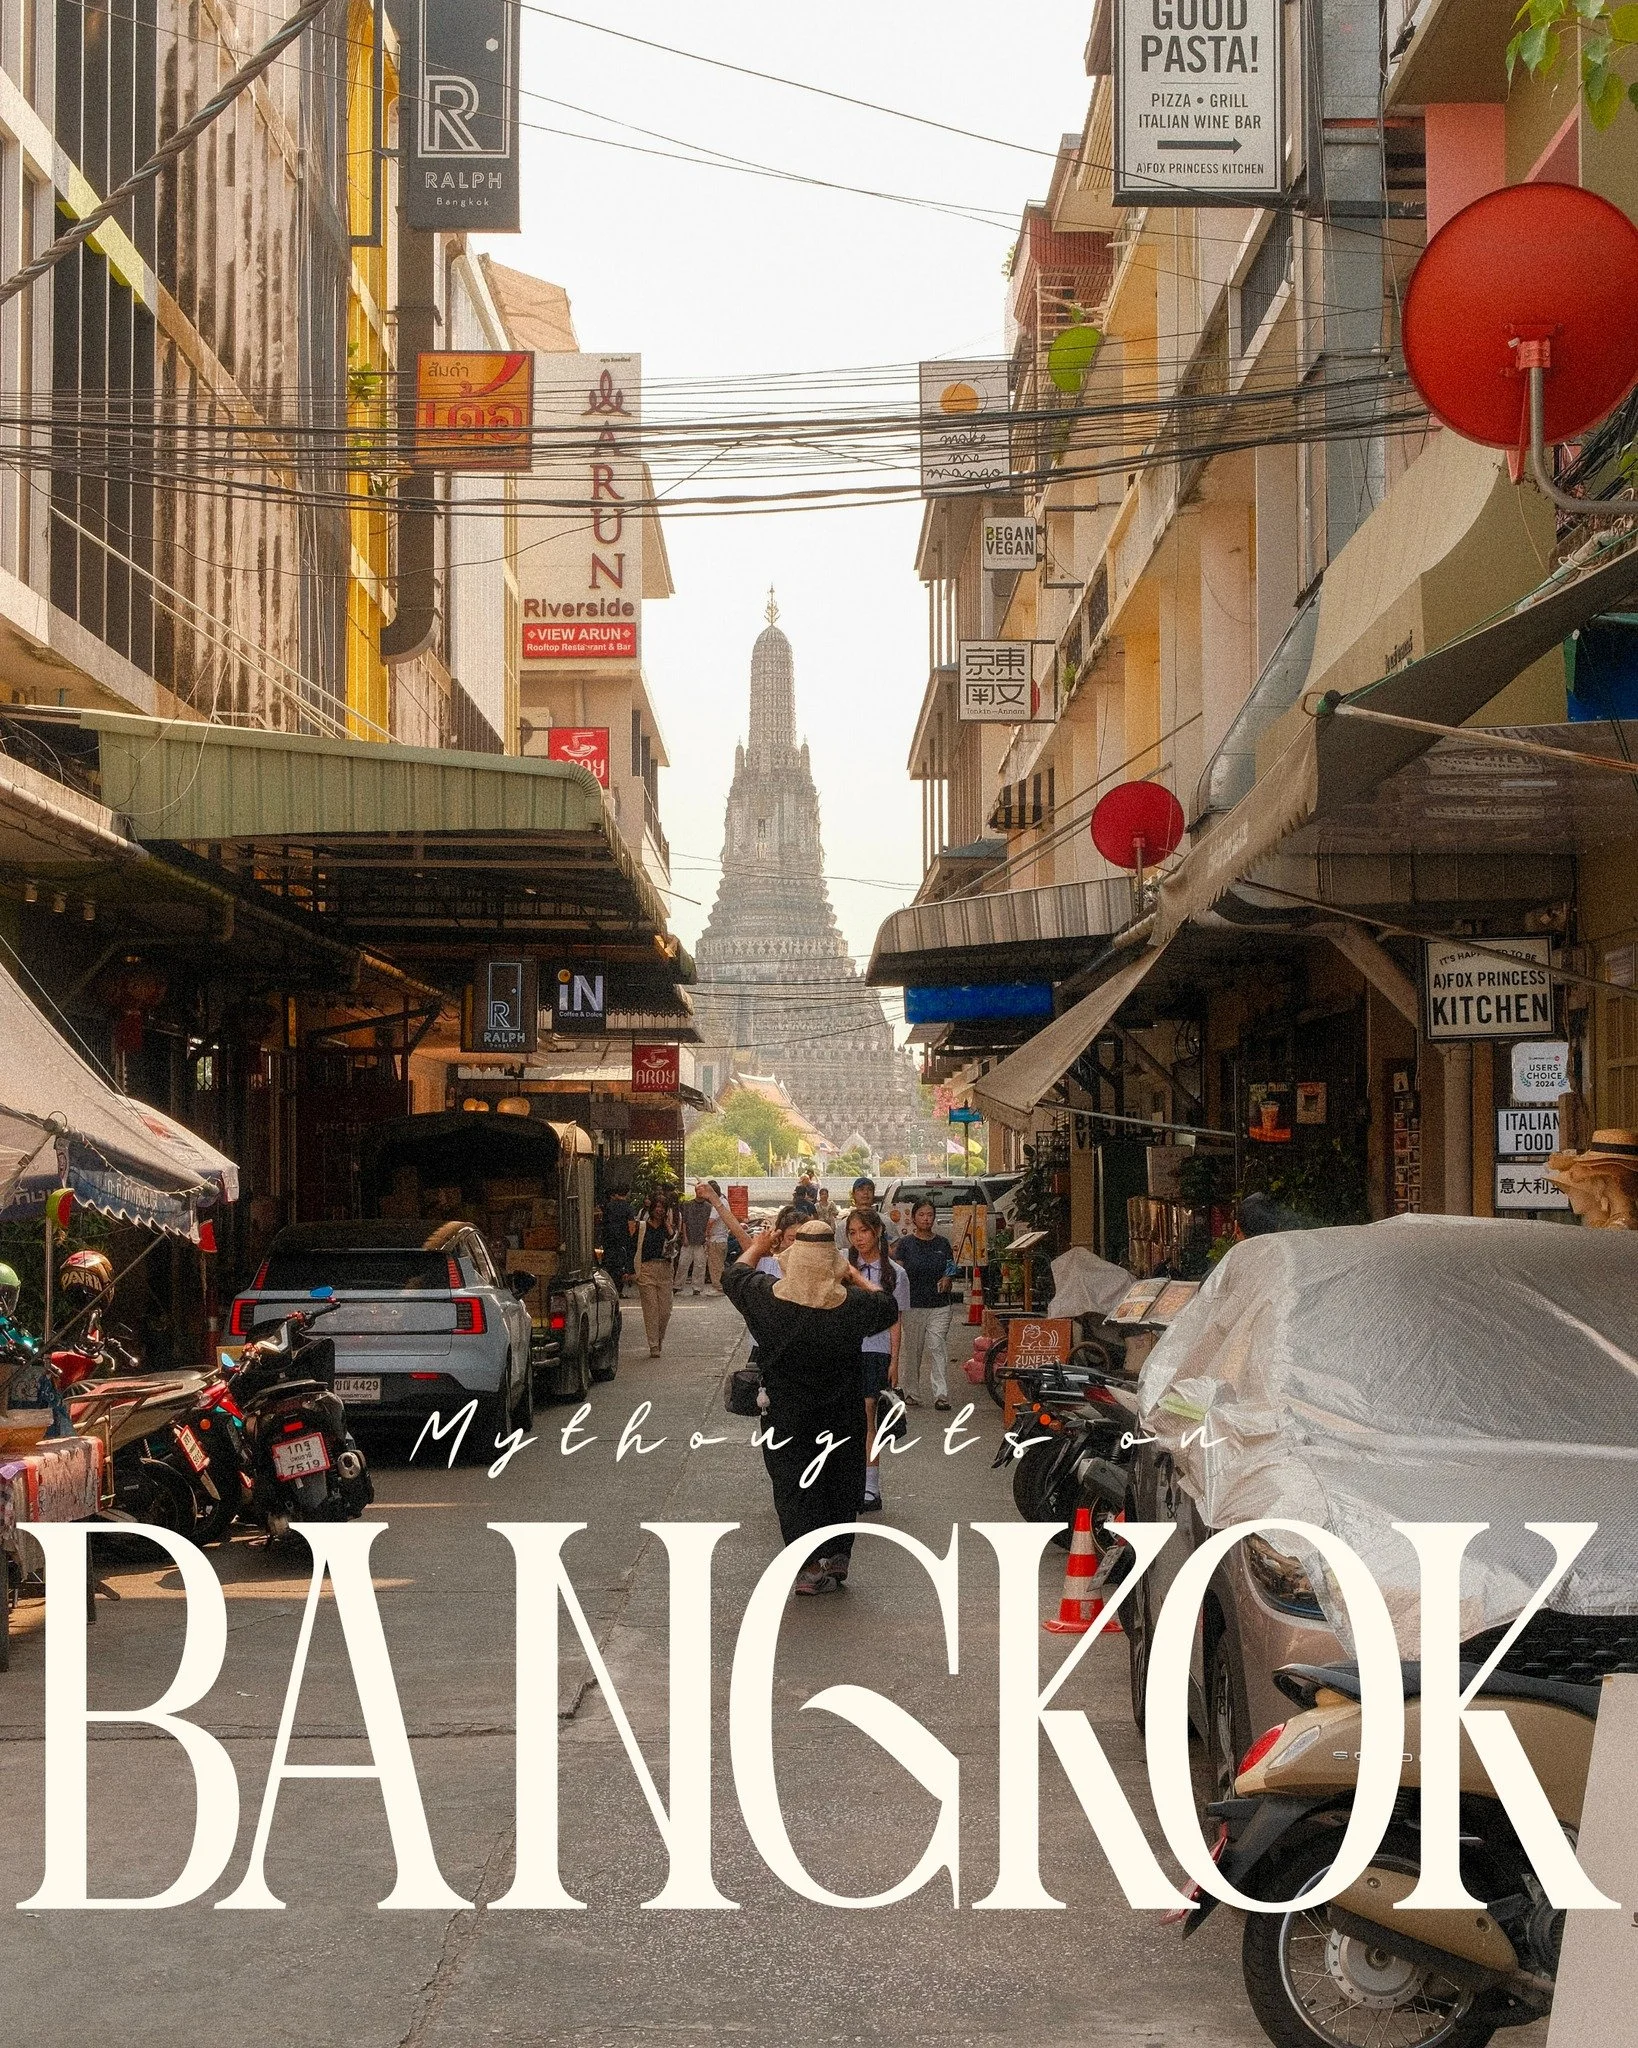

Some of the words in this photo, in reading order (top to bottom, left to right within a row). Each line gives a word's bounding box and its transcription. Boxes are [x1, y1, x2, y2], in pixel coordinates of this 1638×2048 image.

[1152, 0, 1247, 31] GOOD
[1141, 35, 1258, 73] PASTA!
[1152, 93, 1191, 108] PIZZA
[1210, 94, 1248, 108] GRILL
[1139, 114, 1189, 129] ITALIAN
[1194, 115, 1230, 129] WINE
[1235, 115, 1261, 129] BAR
[1169, 163, 1219, 174] PRINCESS
[1222, 163, 1264, 174] KITCHEN
[425, 171, 502, 188] RALPH
[436, 197, 489, 207] Bangkok
[428, 362, 469, 377] ส้มตำ
[588, 420, 625, 589] ARUN
[986, 526, 1034, 540] BEGAN
[986, 541, 1034, 555] VEGAN
[524, 597, 635, 617] Riverside
[537, 628, 576, 640] VIEW
[578, 628, 621, 640] ARUN
[527, 643, 560, 653] Rooftop
[608, 643, 615, 651] &
[617, 643, 632, 651] Bar
[1478, 970, 1546, 987] PRINCESS
[1432, 993, 1549, 1026] KITCHEN
[483, 1032, 525, 1043] RALPH
[636, 1069, 675, 1085] AROY
[1515, 1134, 1554, 1151] FOOD
[353, 1380, 379, 1391] 4429
[287, 1458, 321, 1475] 7519
